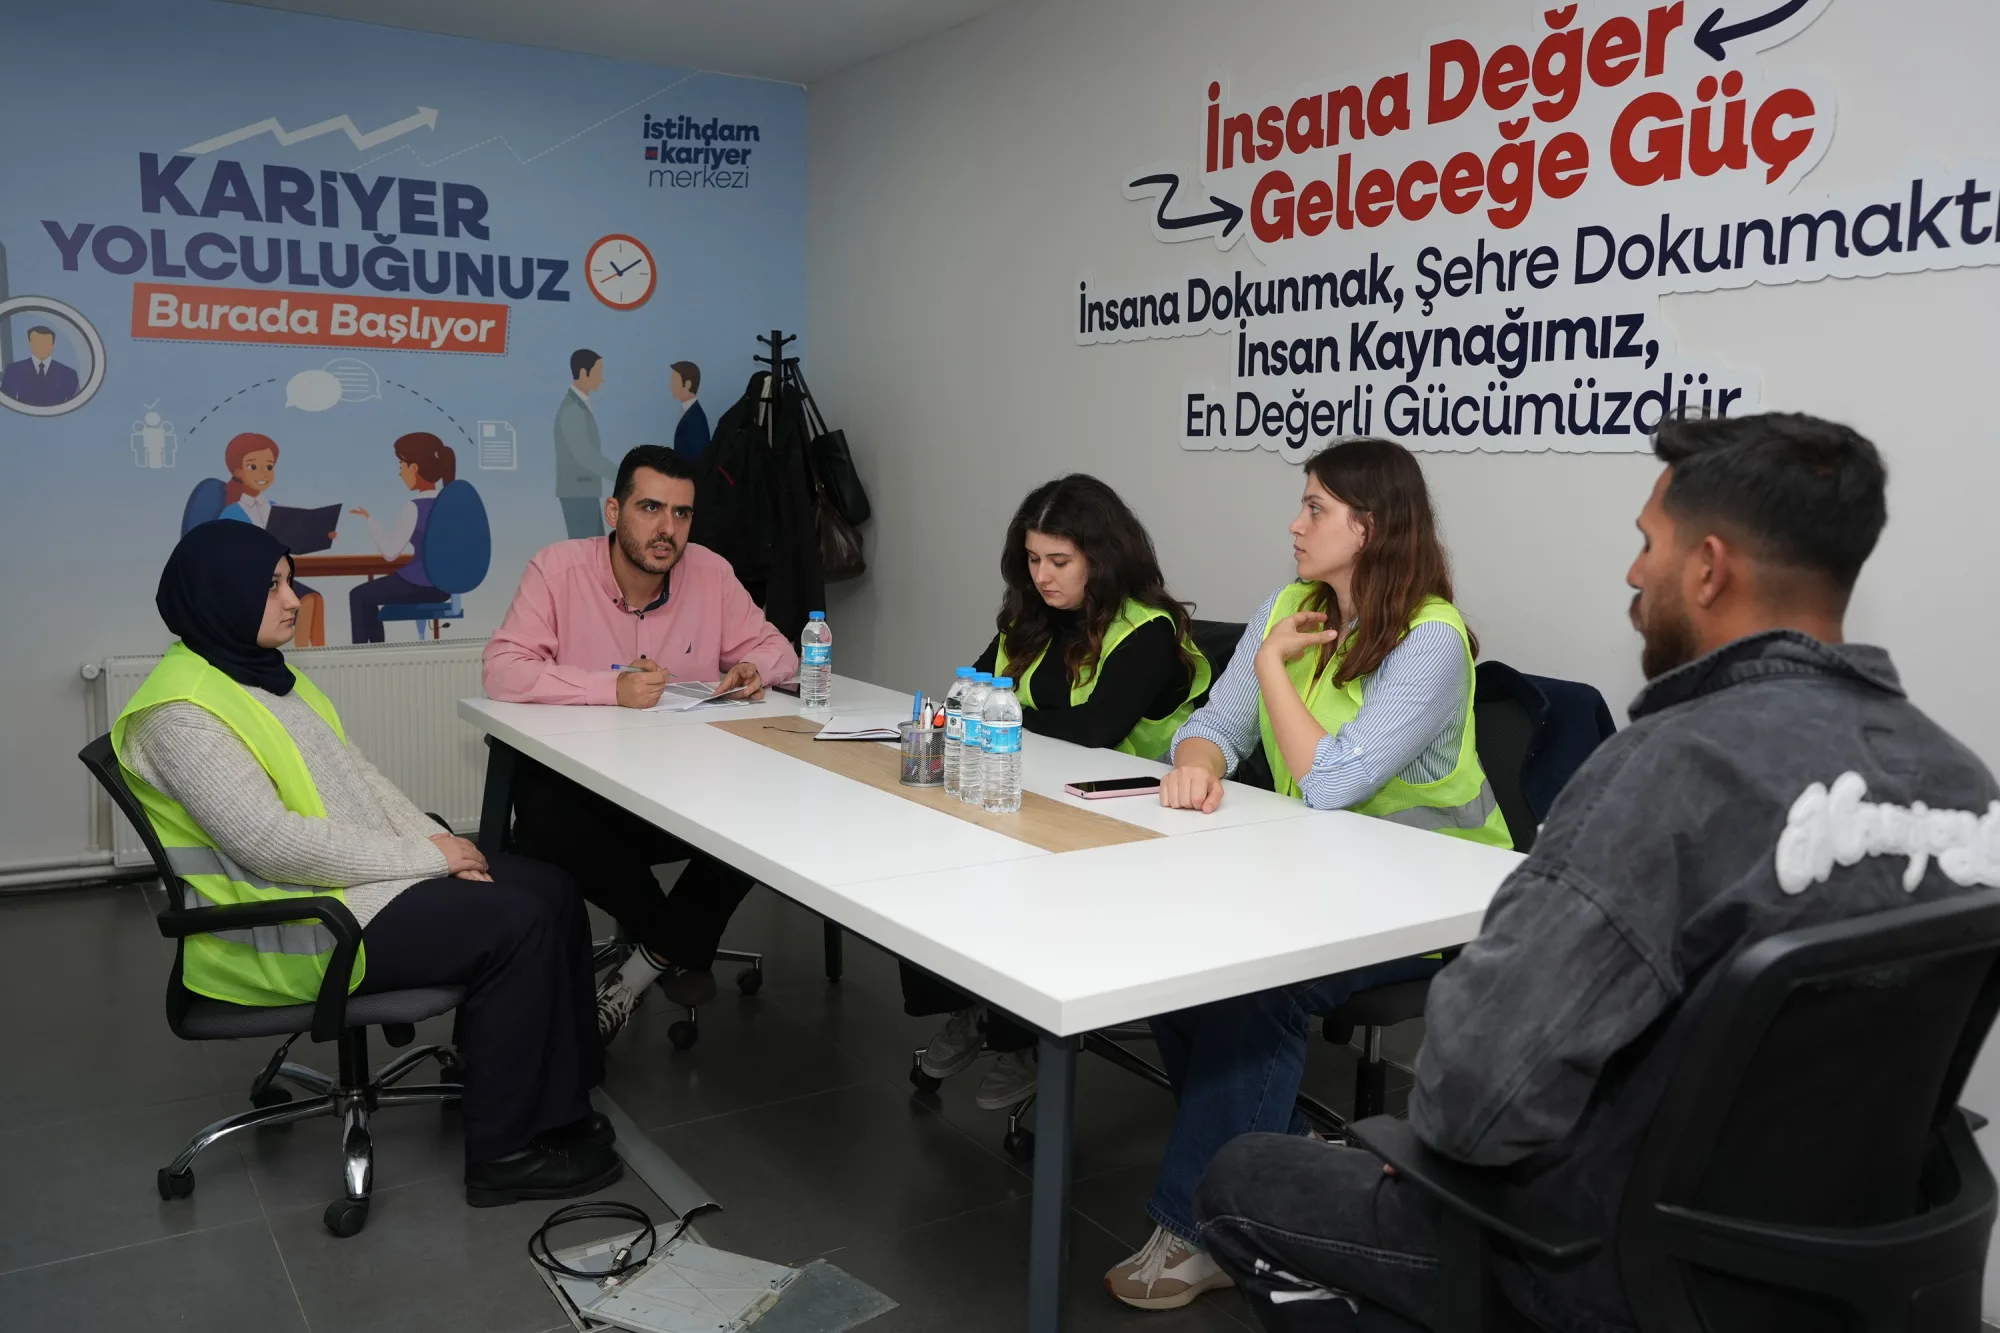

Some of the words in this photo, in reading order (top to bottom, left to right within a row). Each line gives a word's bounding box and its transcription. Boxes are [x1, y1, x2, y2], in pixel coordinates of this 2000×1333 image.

[1206, 80, 1410, 173] İnsana
[1427, 1, 1685, 124] Değer
[643, 113, 760, 142] istihdam
[660, 139, 752, 170] kariyer
[1250, 117, 1589, 243] Geleceğe
[1610, 70, 1816, 187] Güç
[649, 165, 749, 188] merkezi
[41, 220, 571, 302] YOLCULUĞUNUZ
[1080, 282, 1180, 334] İnsana
[1188, 252, 1404, 324] Dokunmak,
[1415, 239, 1559, 316] Şehre
[147, 294, 319, 337] Burada
[330, 303, 496, 352] Başlıyor
[1238, 319, 1340, 377] İnsan
[1350, 307, 1660, 382] Kaynağımız,
[1187, 394, 1227, 437] En
[1236, 384, 1372, 449] Değerli
